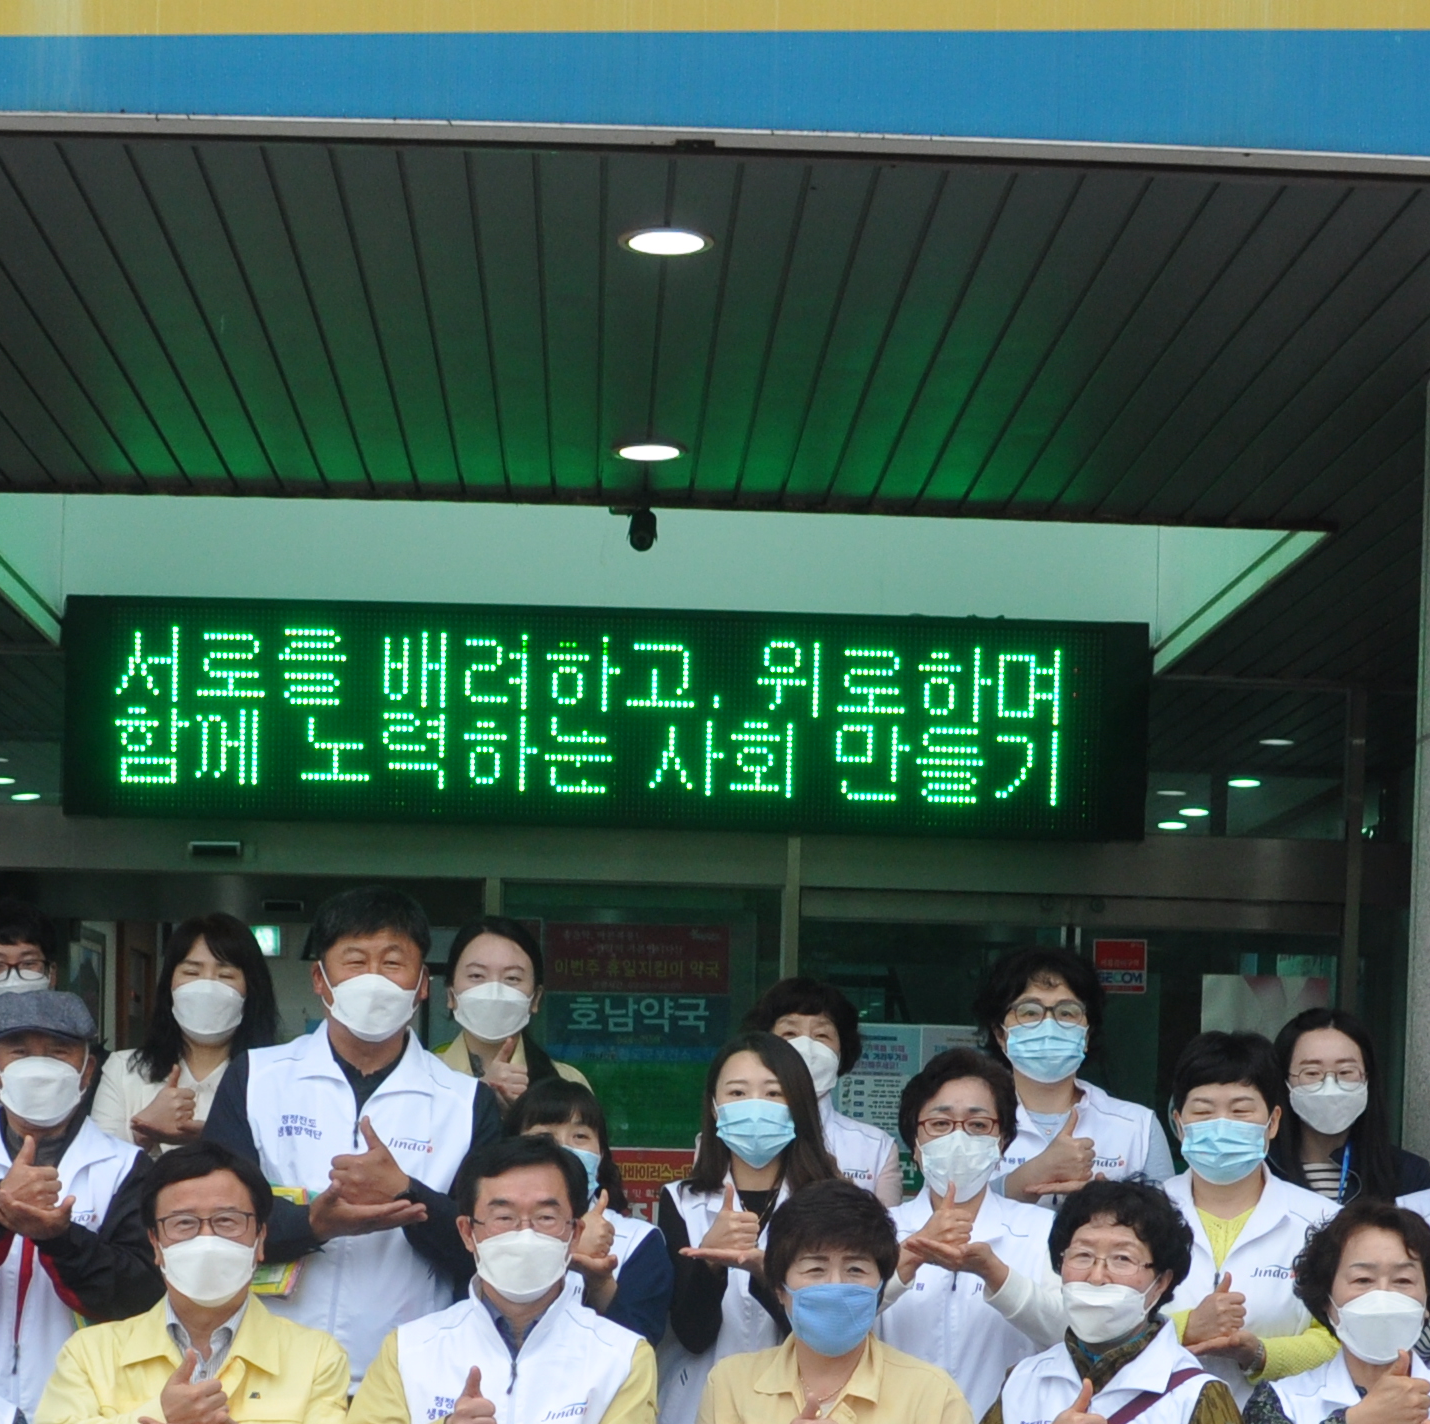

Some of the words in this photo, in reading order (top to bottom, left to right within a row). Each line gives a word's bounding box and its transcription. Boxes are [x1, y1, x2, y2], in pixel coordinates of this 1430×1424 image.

[115, 625, 347, 705] 서로를
[384, 630, 720, 712] 배려하고,
[756, 640, 1060, 726] 위로하며
[114, 706, 259, 787] 함께
[301, 712, 613, 793] 노력하는
[648, 720, 794, 798] 사회
[836, 723, 1058, 807] 만들기
[567, 997, 709, 1033] 호남약국
[378, 1137, 426, 1152] Jindo
[1250, 1267, 1289, 1280] Jindo
[541, 1405, 585, 1423] Jindo
